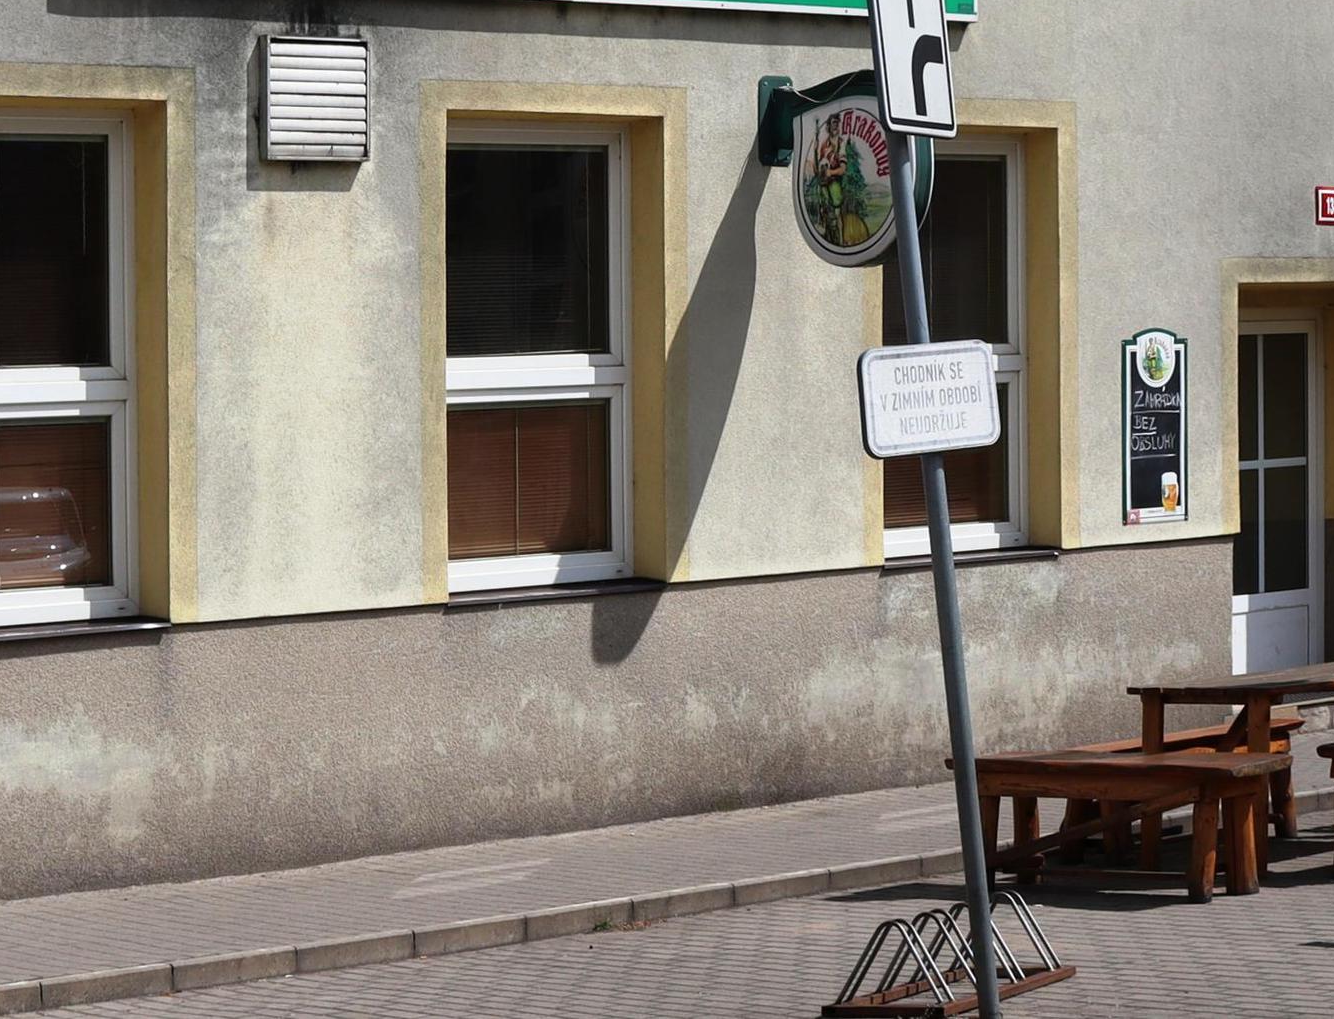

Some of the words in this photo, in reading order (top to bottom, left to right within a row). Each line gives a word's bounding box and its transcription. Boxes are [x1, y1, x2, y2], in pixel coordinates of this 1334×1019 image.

[893, 359, 946, 385] CHODNÍK
[949, 361, 965, 380] SE
[880, 393, 888, 412] V
[892, 385, 935, 411] ZIMNÍM
[938, 380, 982, 406] OBDOBÍ
[899, 409, 968, 436] NEUDRŽUJE
[1133, 416, 1157, 431] BEZ
